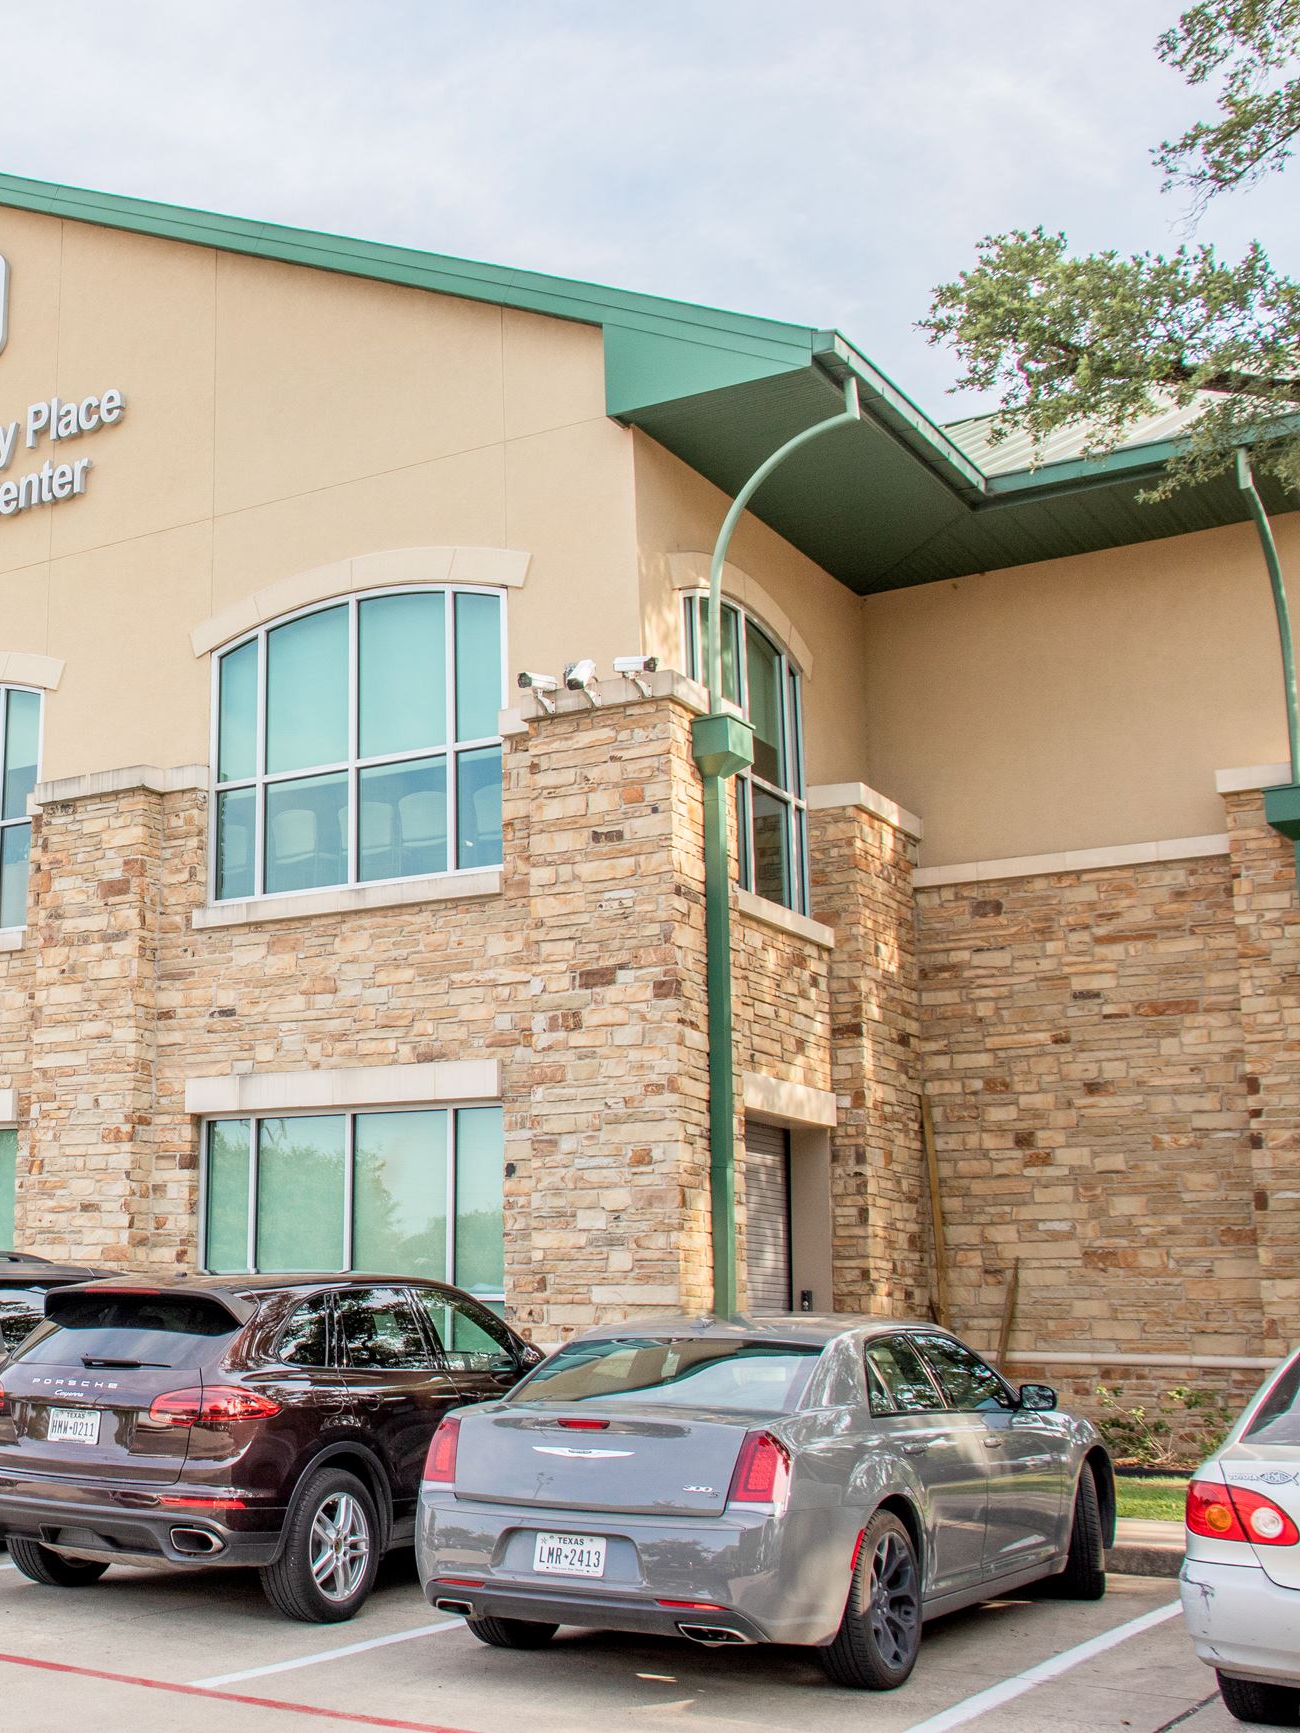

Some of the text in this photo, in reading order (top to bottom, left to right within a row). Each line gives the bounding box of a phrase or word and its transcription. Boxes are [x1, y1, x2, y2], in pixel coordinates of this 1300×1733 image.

[25, 388, 127, 449] Place
[32, 1377, 118, 1389] PORSCHE
[54, 1389, 84, 1398] Cayenne
[66, 1411, 86, 1419] TEXAS
[1228, 1473, 1259, 1481] TOYOTA
[682, 1484, 713, 1493] 300
[557, 1536, 585, 1546] TEXAS
